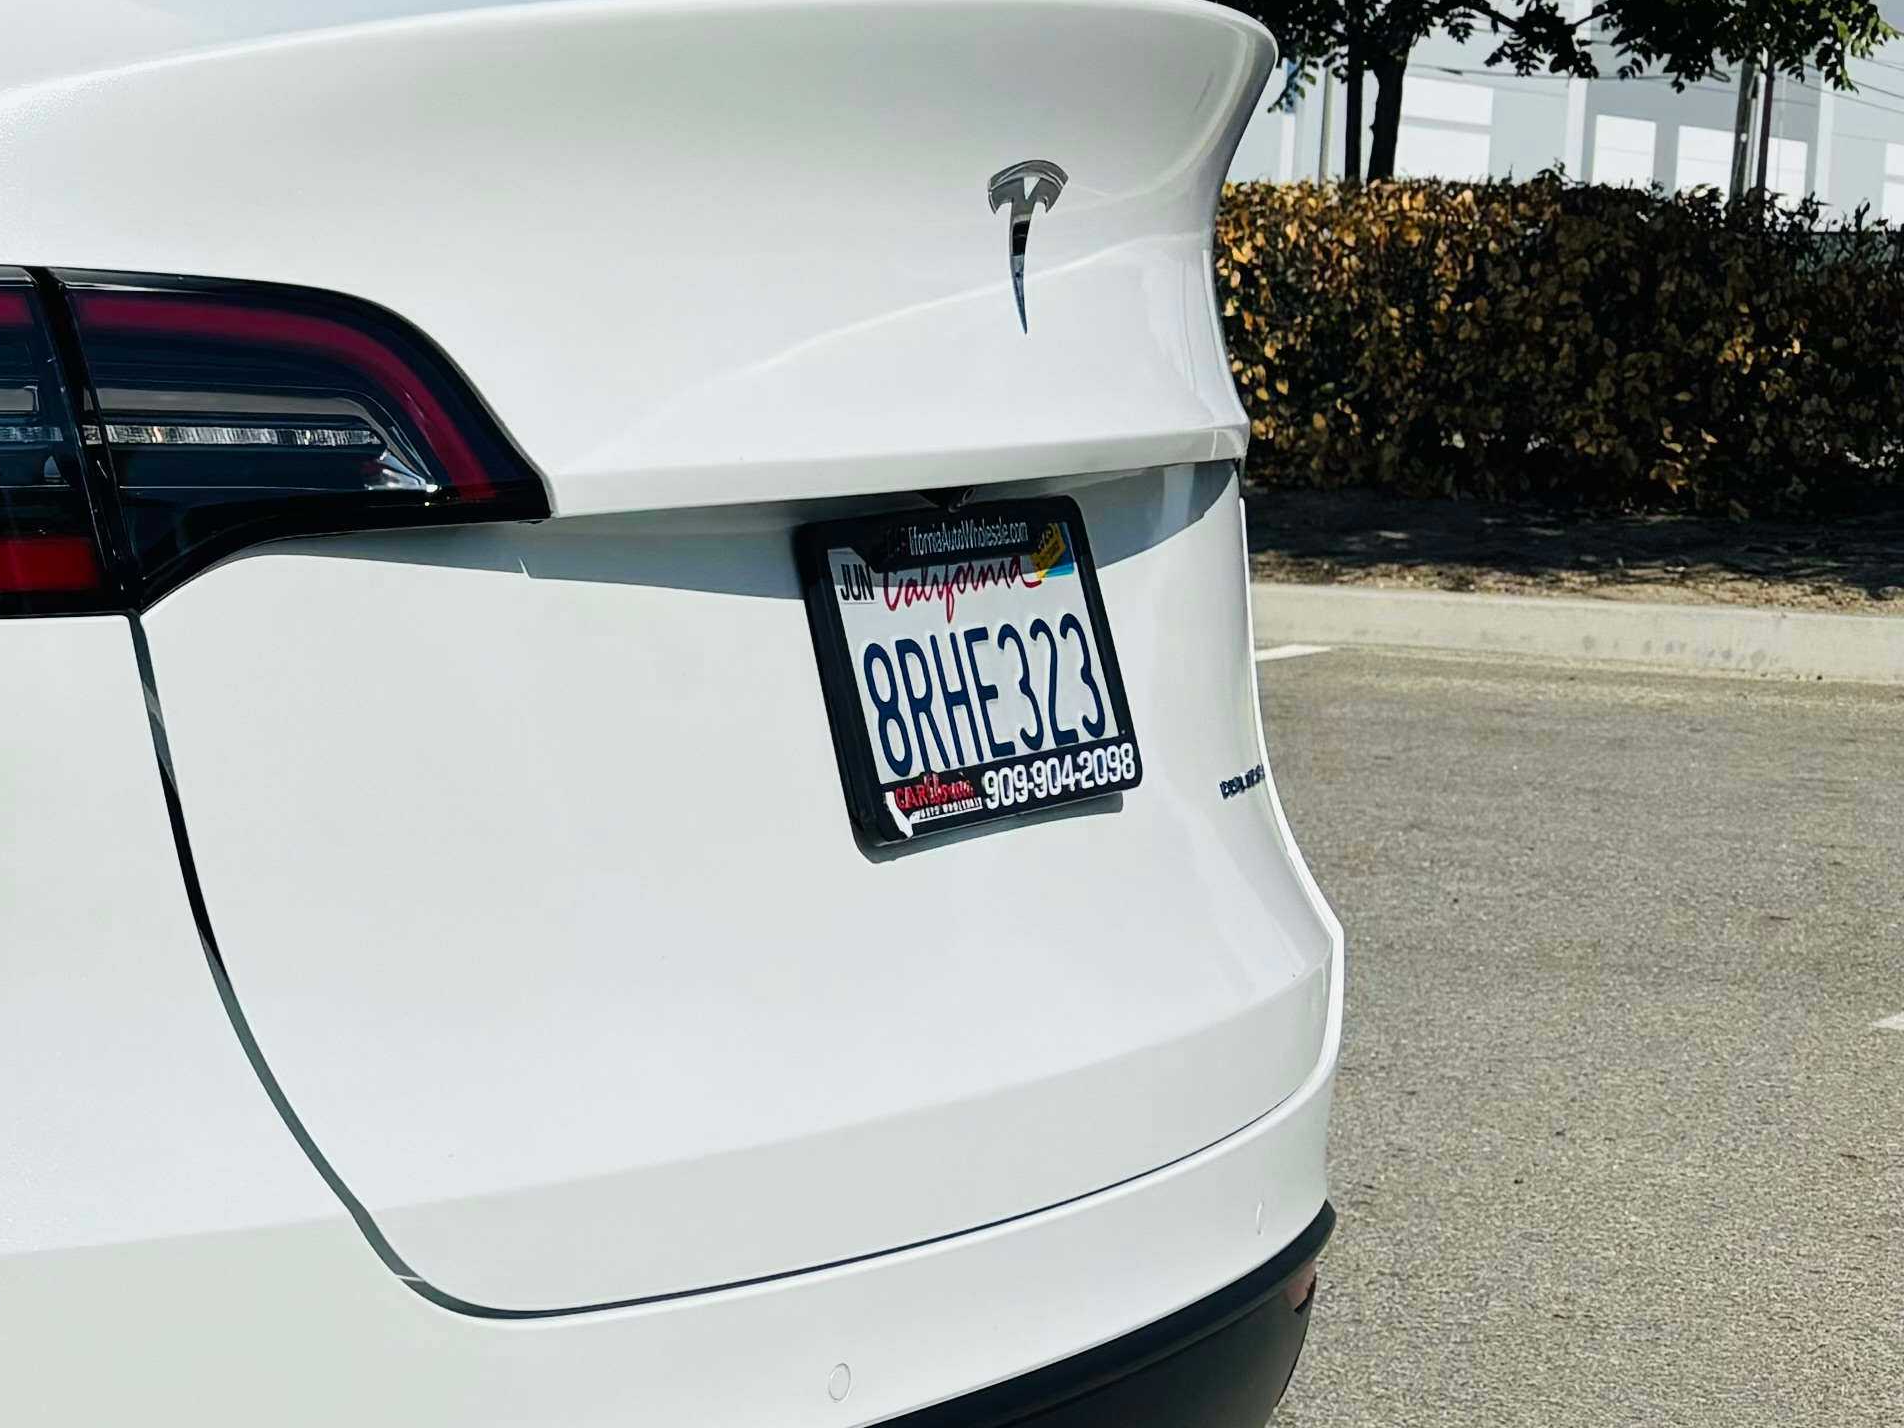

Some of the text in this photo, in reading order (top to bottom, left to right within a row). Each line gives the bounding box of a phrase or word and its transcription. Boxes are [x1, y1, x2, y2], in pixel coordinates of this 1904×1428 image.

[840, 555, 1042, 623] JUN California
[863, 613, 1106, 778] 8RHE323
[982, 742, 1136, 811] 909-904-2098
